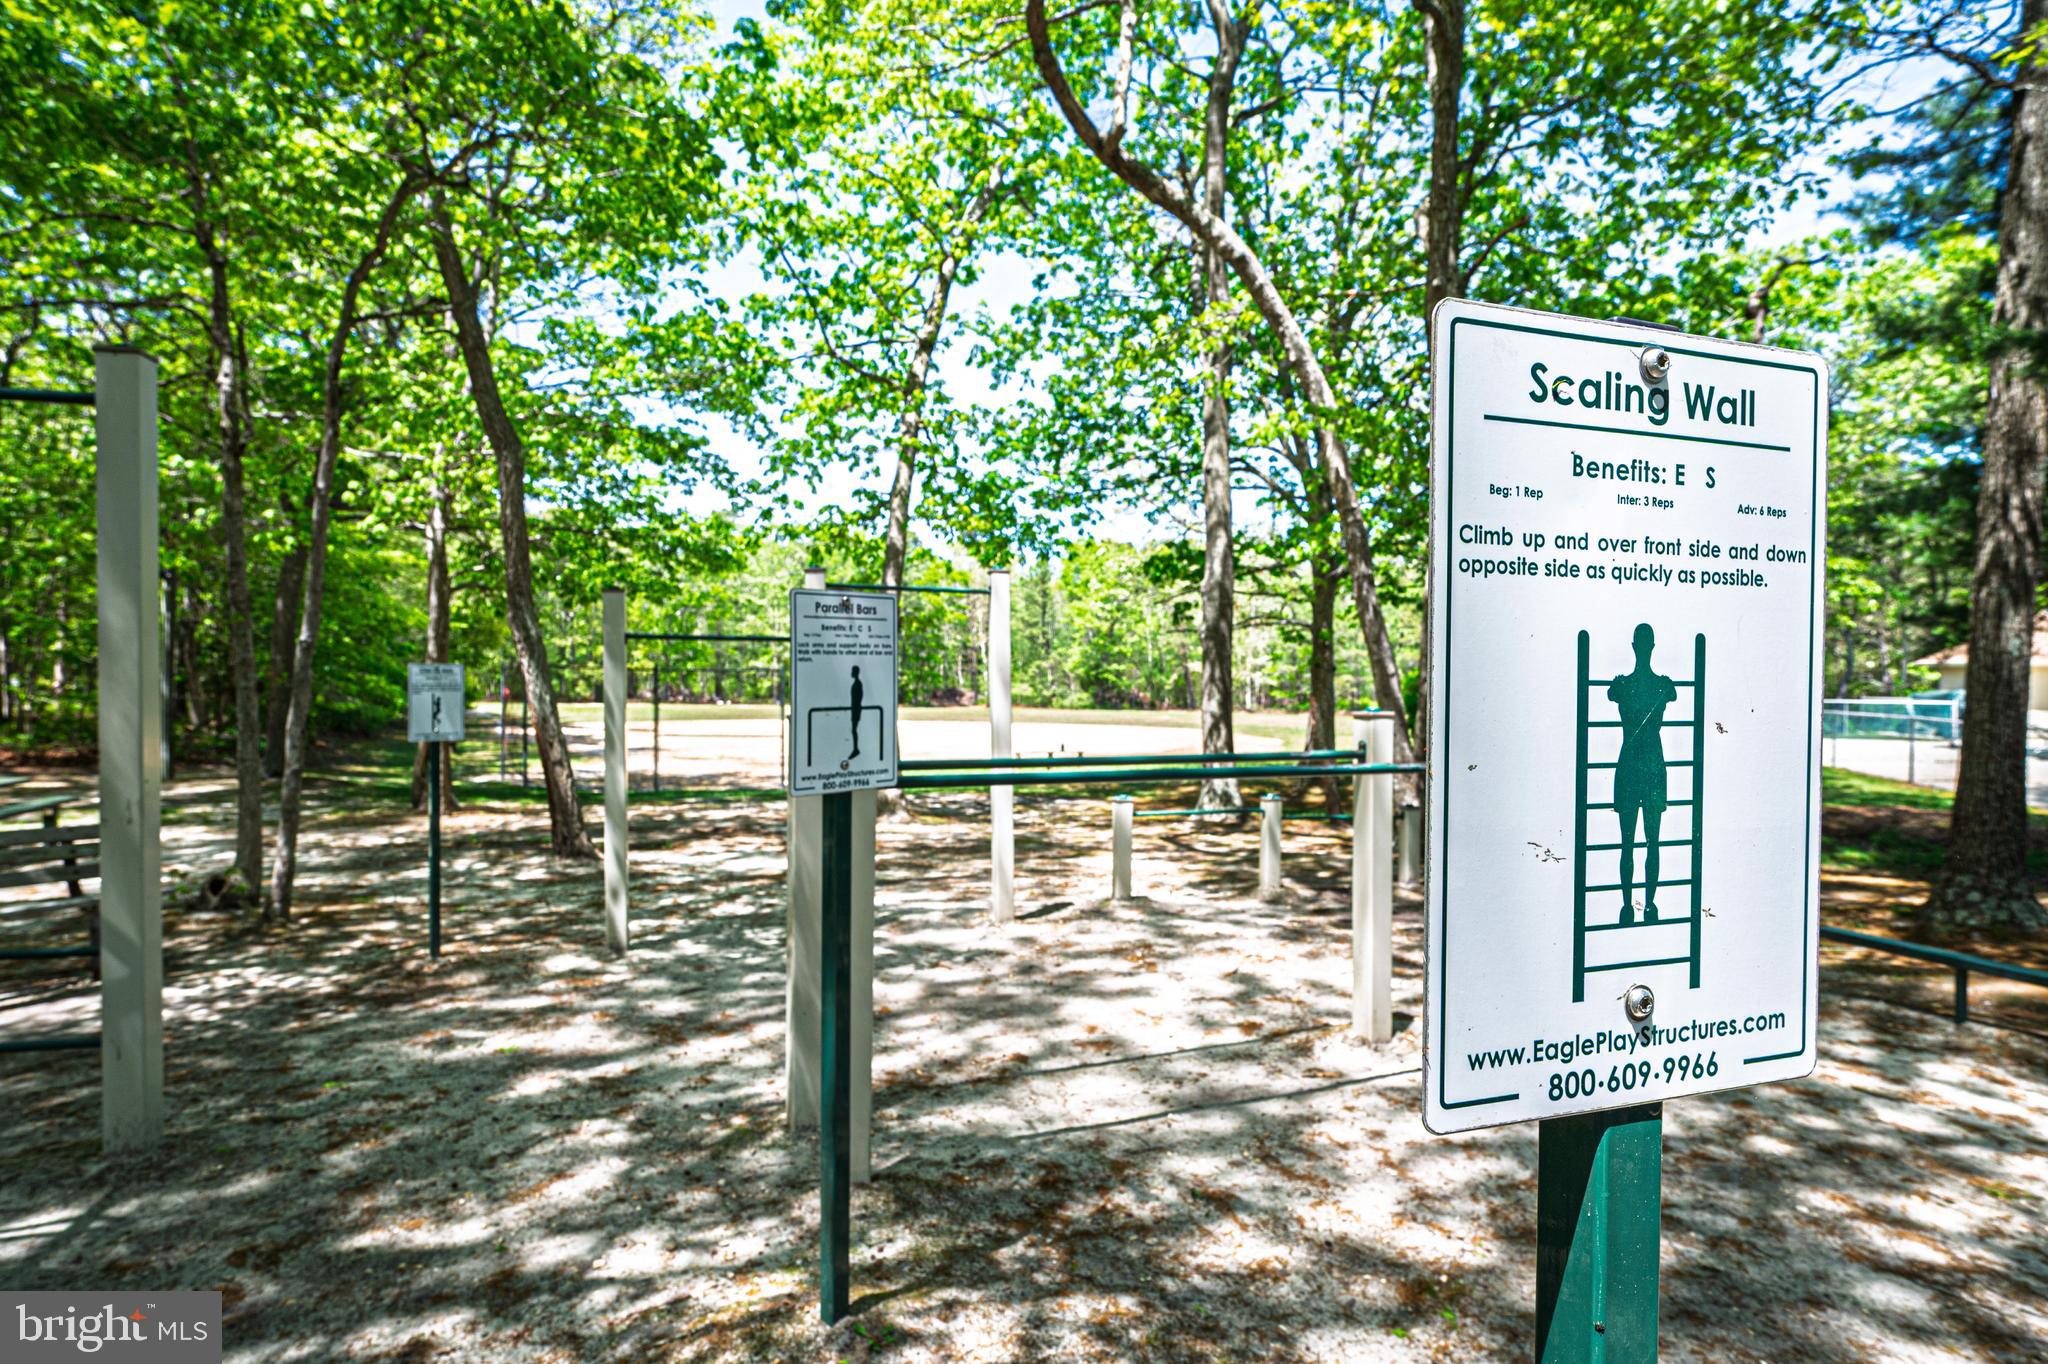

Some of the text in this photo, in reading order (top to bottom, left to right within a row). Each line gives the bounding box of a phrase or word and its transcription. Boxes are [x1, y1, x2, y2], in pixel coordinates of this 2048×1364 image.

[1529, 363, 1756, 427] Scaling Wall
[1572, 454, 1716, 489] Benefits: E S
[1489, 484, 1543, 501] Beg: 1 Rep
[1617, 494, 1674, 509] Inter: 3 Reps
[1737, 505, 1786, 518] Adv: 6 Reps
[1459, 524, 1807, 564] Climb up and over front side and down
[1458, 556, 1768, 588] opposite side as quickly as possible.
[815, 602, 877, 615] Parallel Bars
[1468, 1011, 1785, 1071] www.EaglePlayStructures.com
